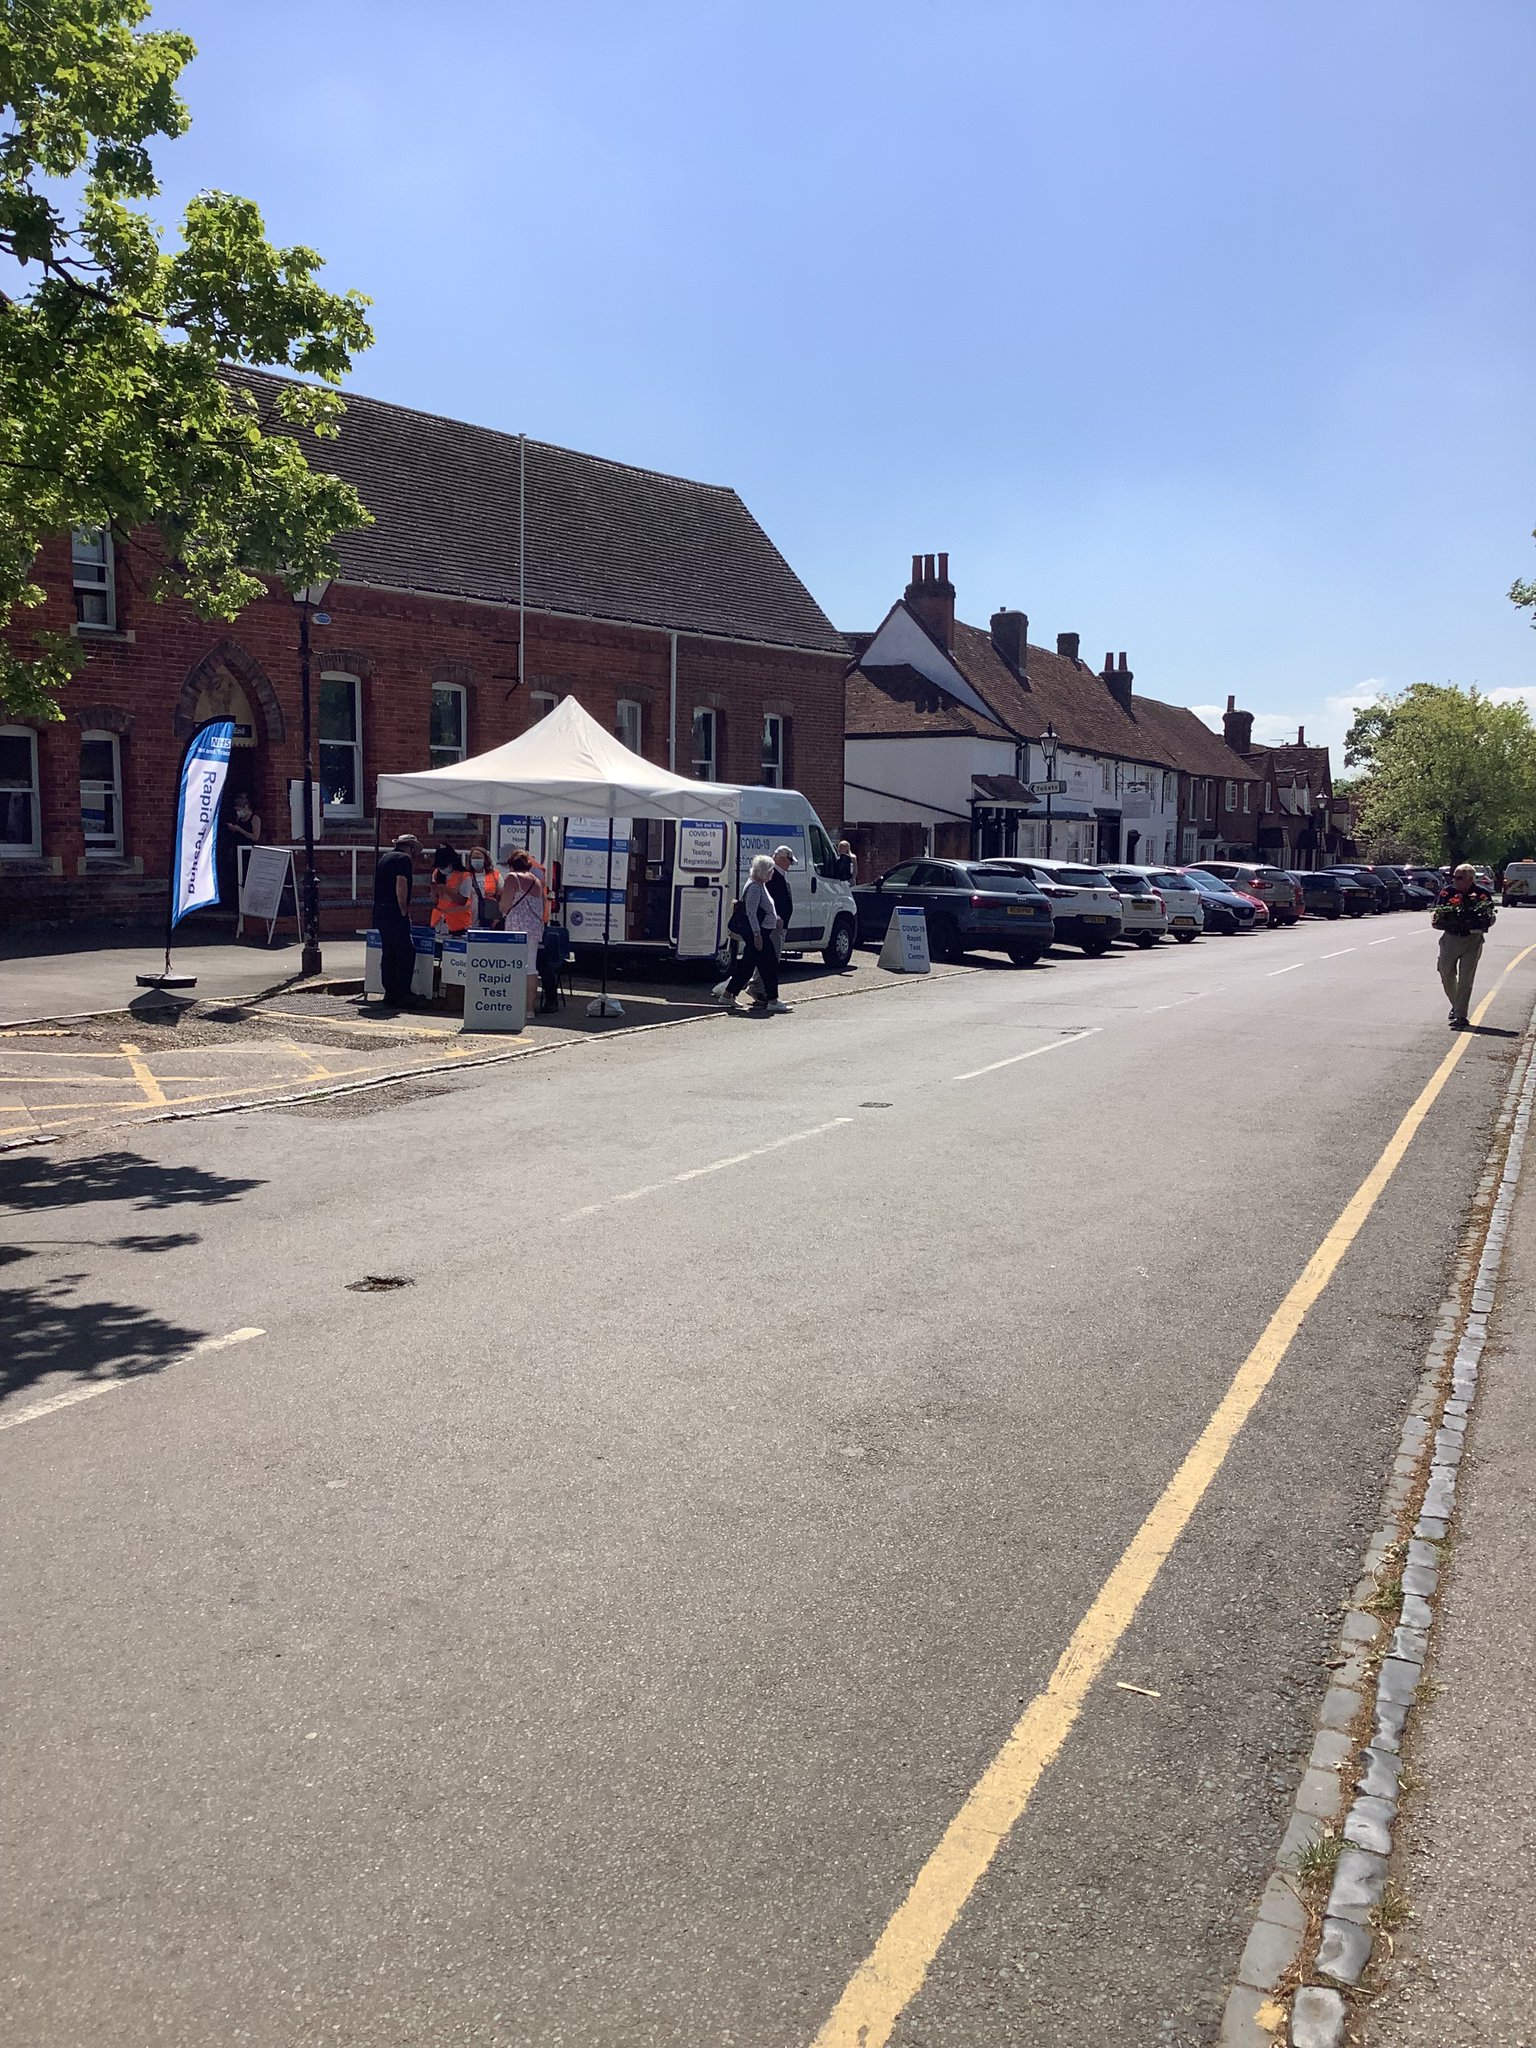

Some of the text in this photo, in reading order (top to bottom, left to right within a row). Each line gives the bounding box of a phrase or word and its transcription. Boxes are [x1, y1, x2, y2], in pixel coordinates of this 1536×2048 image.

[212, 738, 231, 748] NHS
[200, 770, 217, 823] Rapid
[689, 830, 716, 838] COVID-19
[694, 839, 711, 848] Rapid
[741, 837, 770, 850] COVID-19
[692, 848, 712, 857] Testing
[683, 858, 720, 866] Registration
[902, 924, 925, 932] COVID-19
[907, 934, 922, 942] Rapid
[910, 943, 921, 951] Test
[471, 958, 523, 969] COVID-19
[479, 973, 511, 985] Rapid
[482, 987, 507, 997] Test
[475, 1001, 513, 1012] Centre
